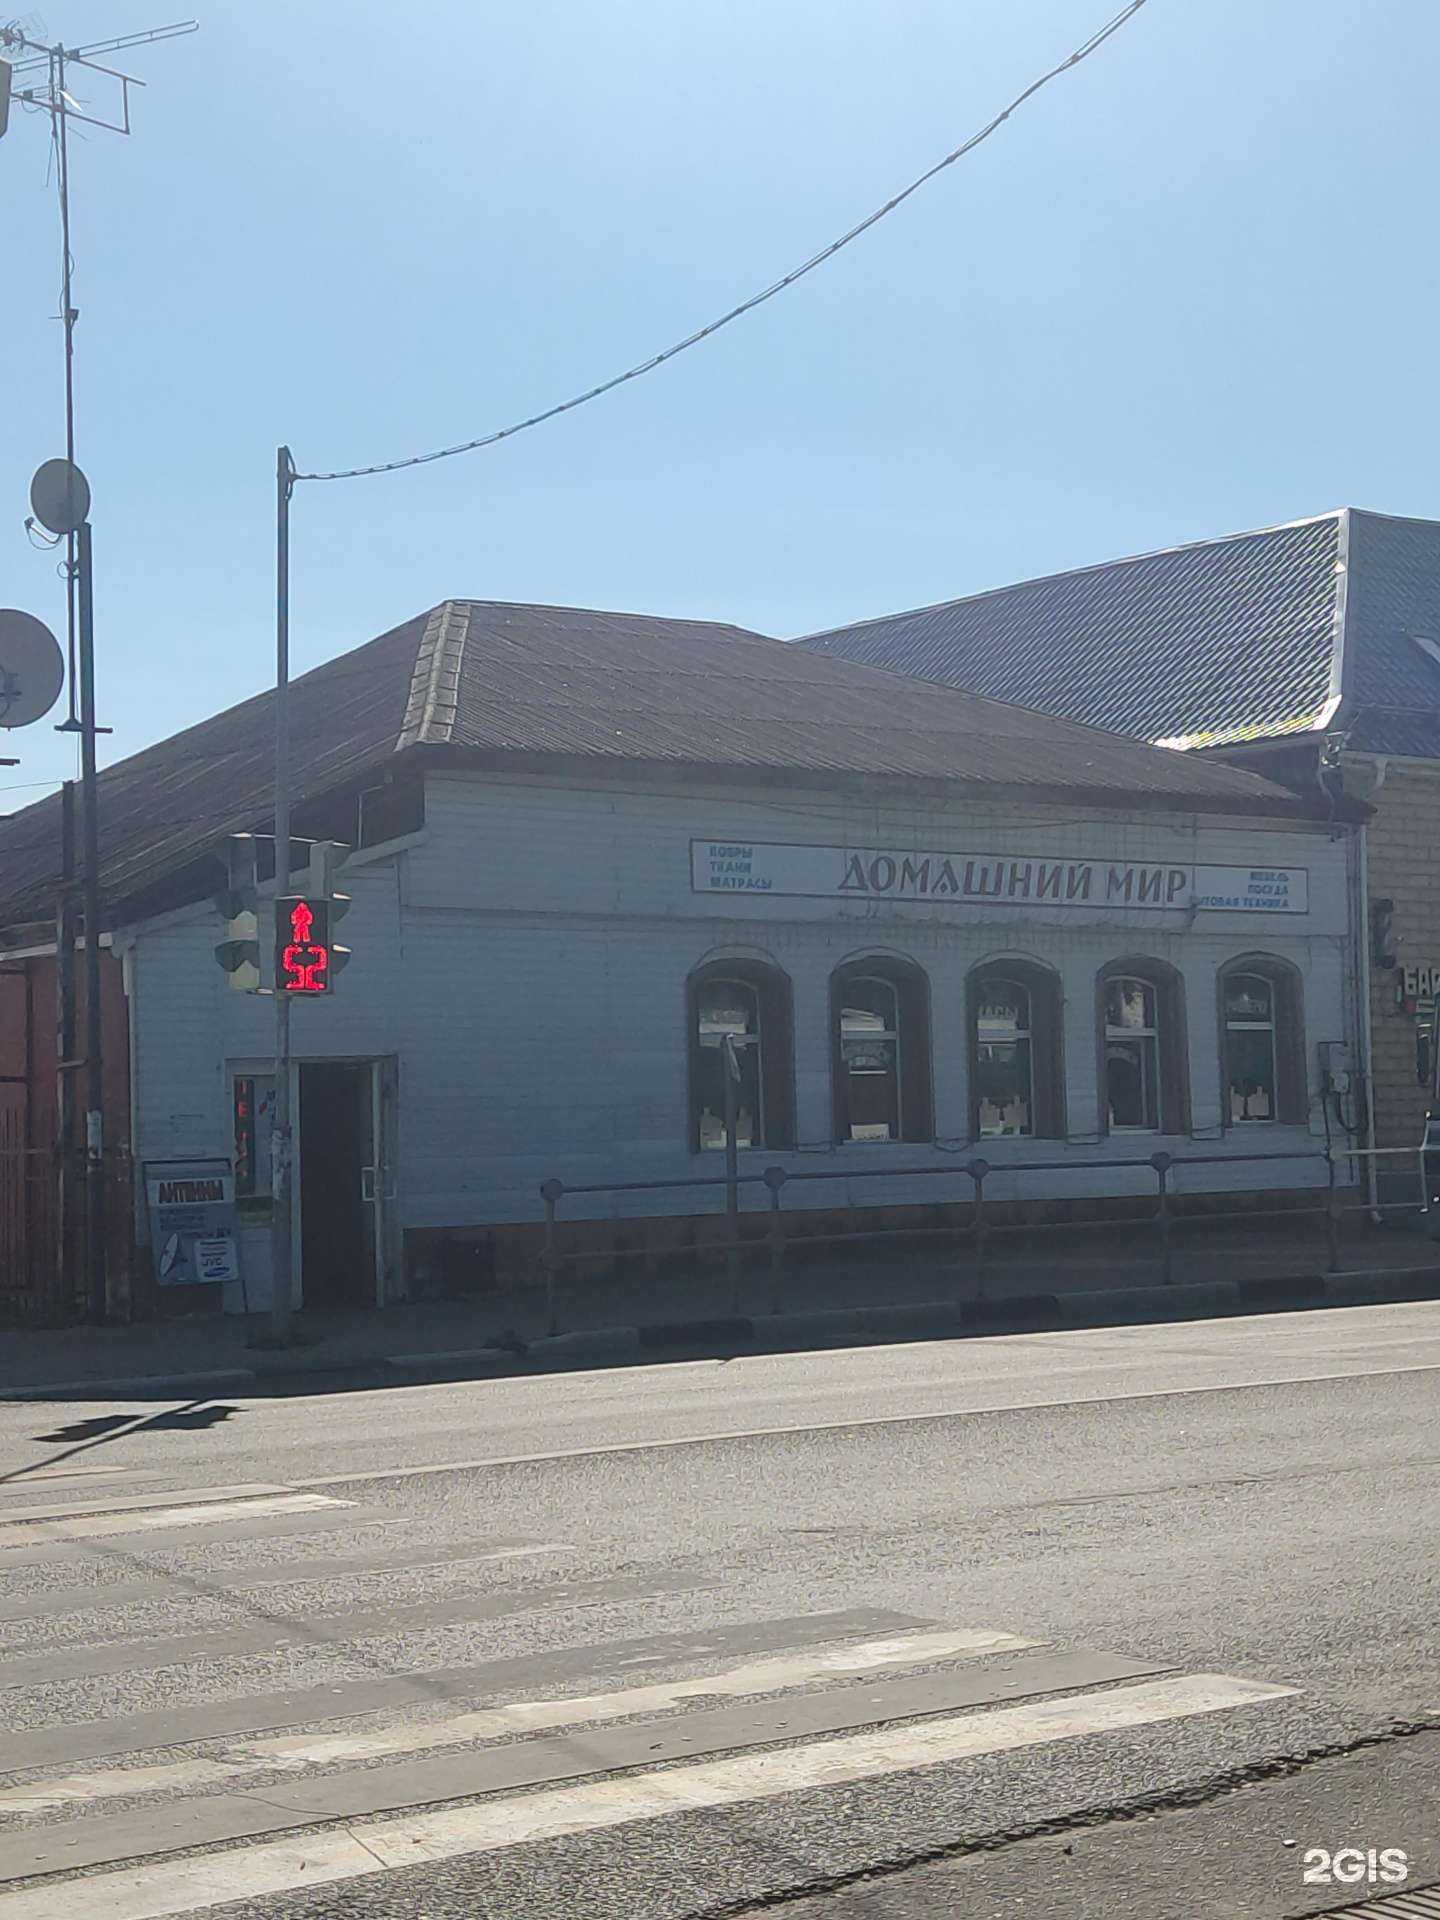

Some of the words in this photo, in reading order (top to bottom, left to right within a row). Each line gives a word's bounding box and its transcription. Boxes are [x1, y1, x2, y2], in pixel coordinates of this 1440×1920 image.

[837, 854, 1092, 900] ДОМАШНИЙ
[1106, 864, 1187, 902] МИР
[282, 944, 327, 990] 52
